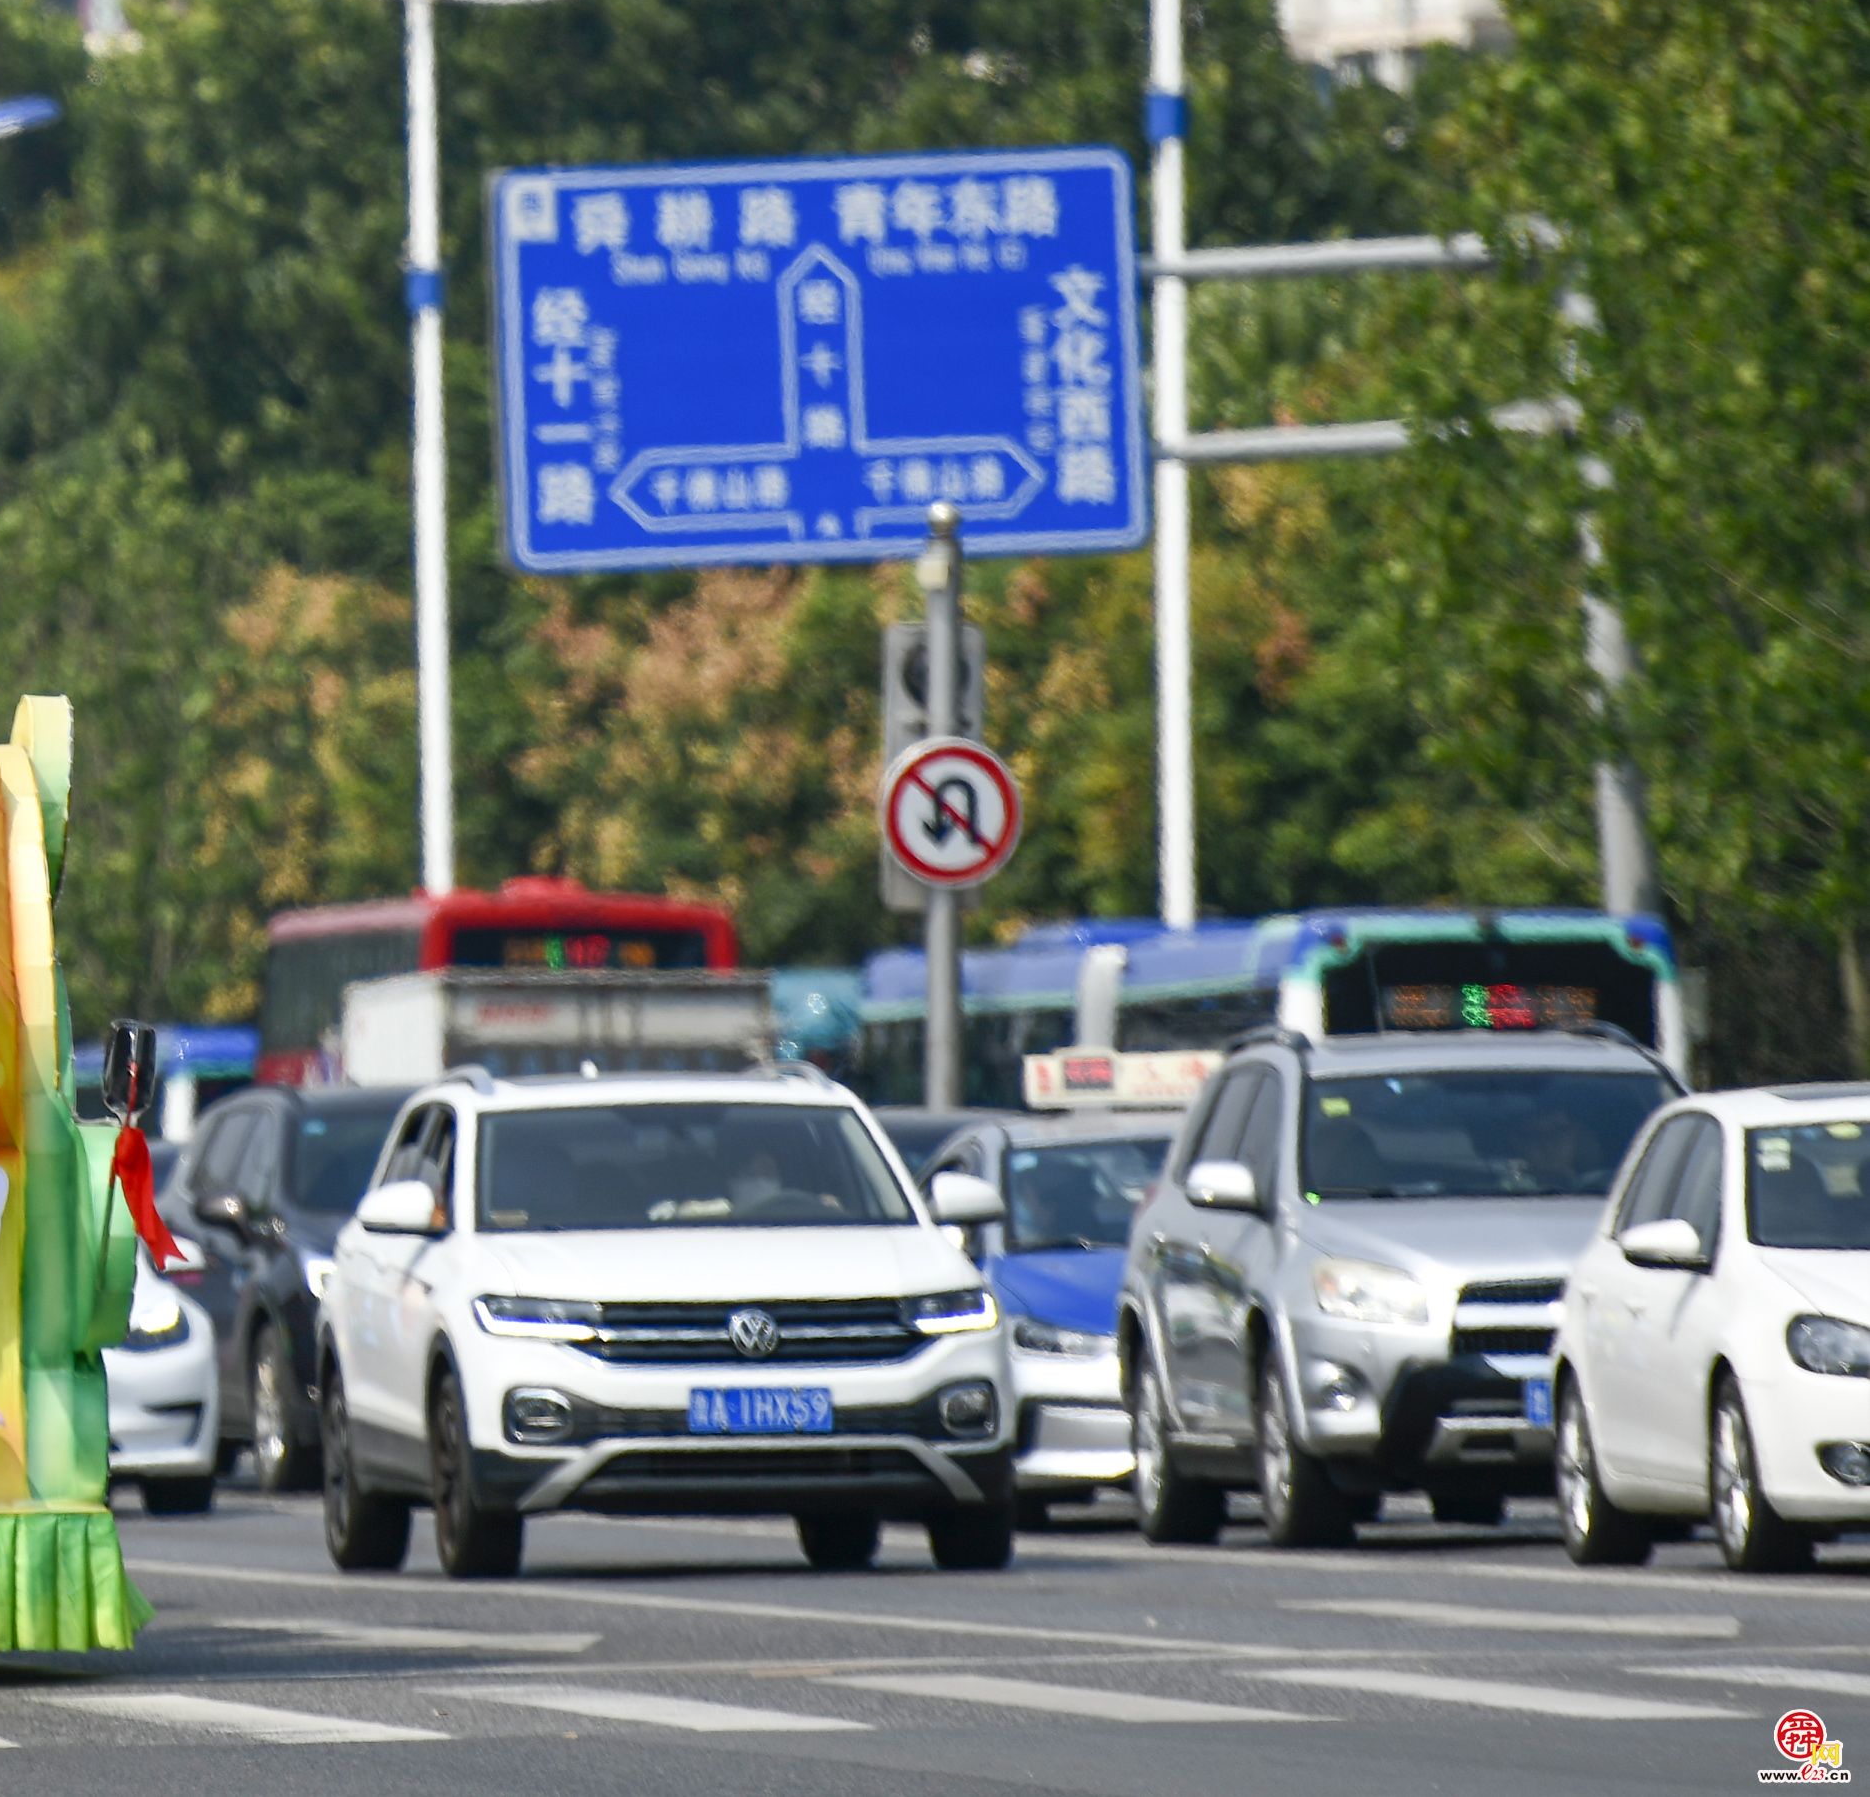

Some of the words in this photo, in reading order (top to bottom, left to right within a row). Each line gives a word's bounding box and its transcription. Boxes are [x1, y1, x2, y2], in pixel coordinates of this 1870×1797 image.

[832, 175, 1058, 246] 青年东路
[532, 286, 595, 525] 经十一路
[1049, 264, 1116, 505] 文化西路
